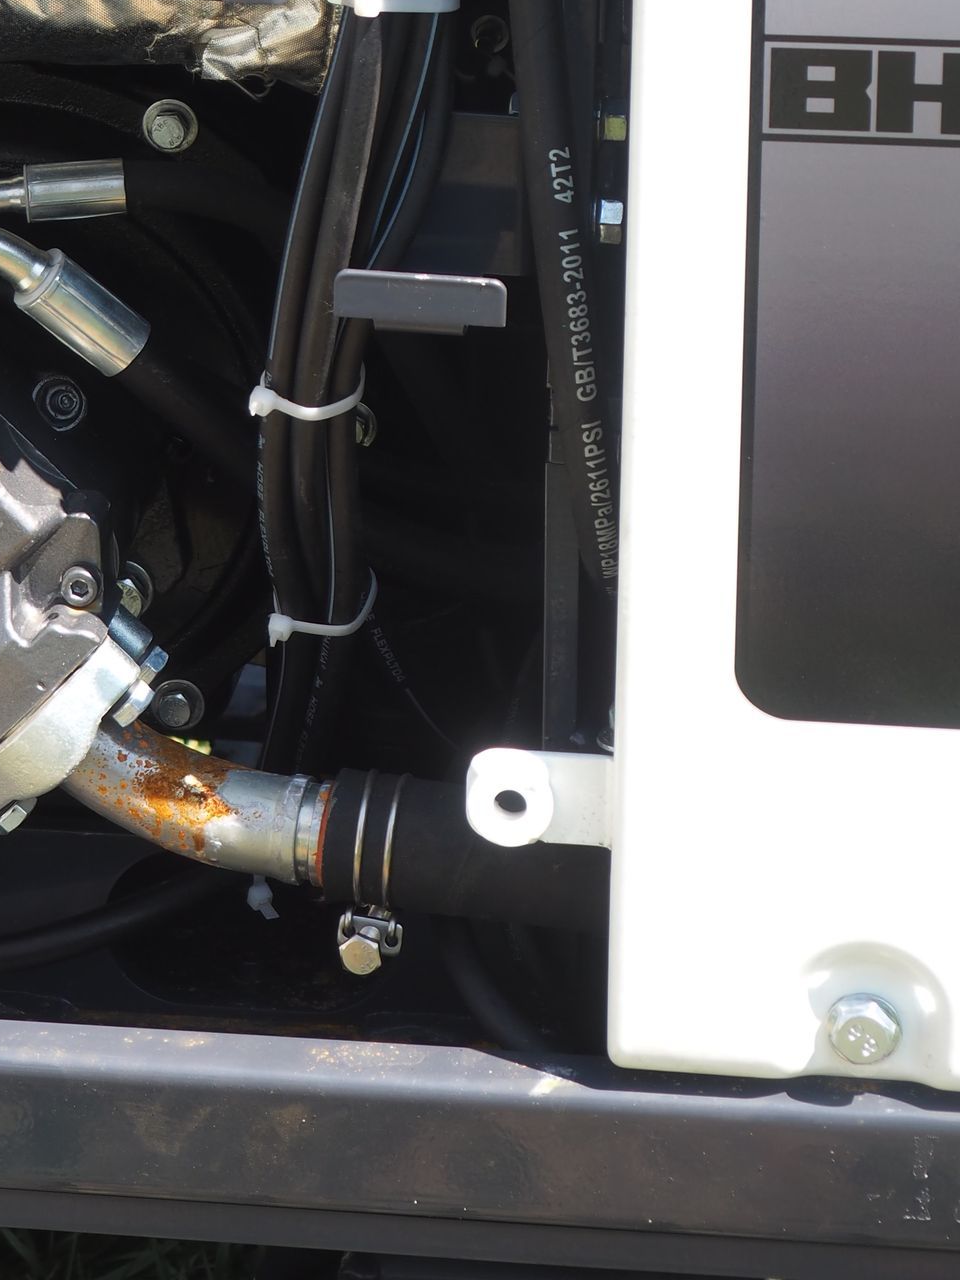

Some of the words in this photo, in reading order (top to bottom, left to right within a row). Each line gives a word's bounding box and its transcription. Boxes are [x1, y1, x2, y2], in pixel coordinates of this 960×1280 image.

[769, 47, 960, 135] BH
[548, 147, 573, 204] 42T2
[558, 228, 597, 402] GB/T3683-2011
